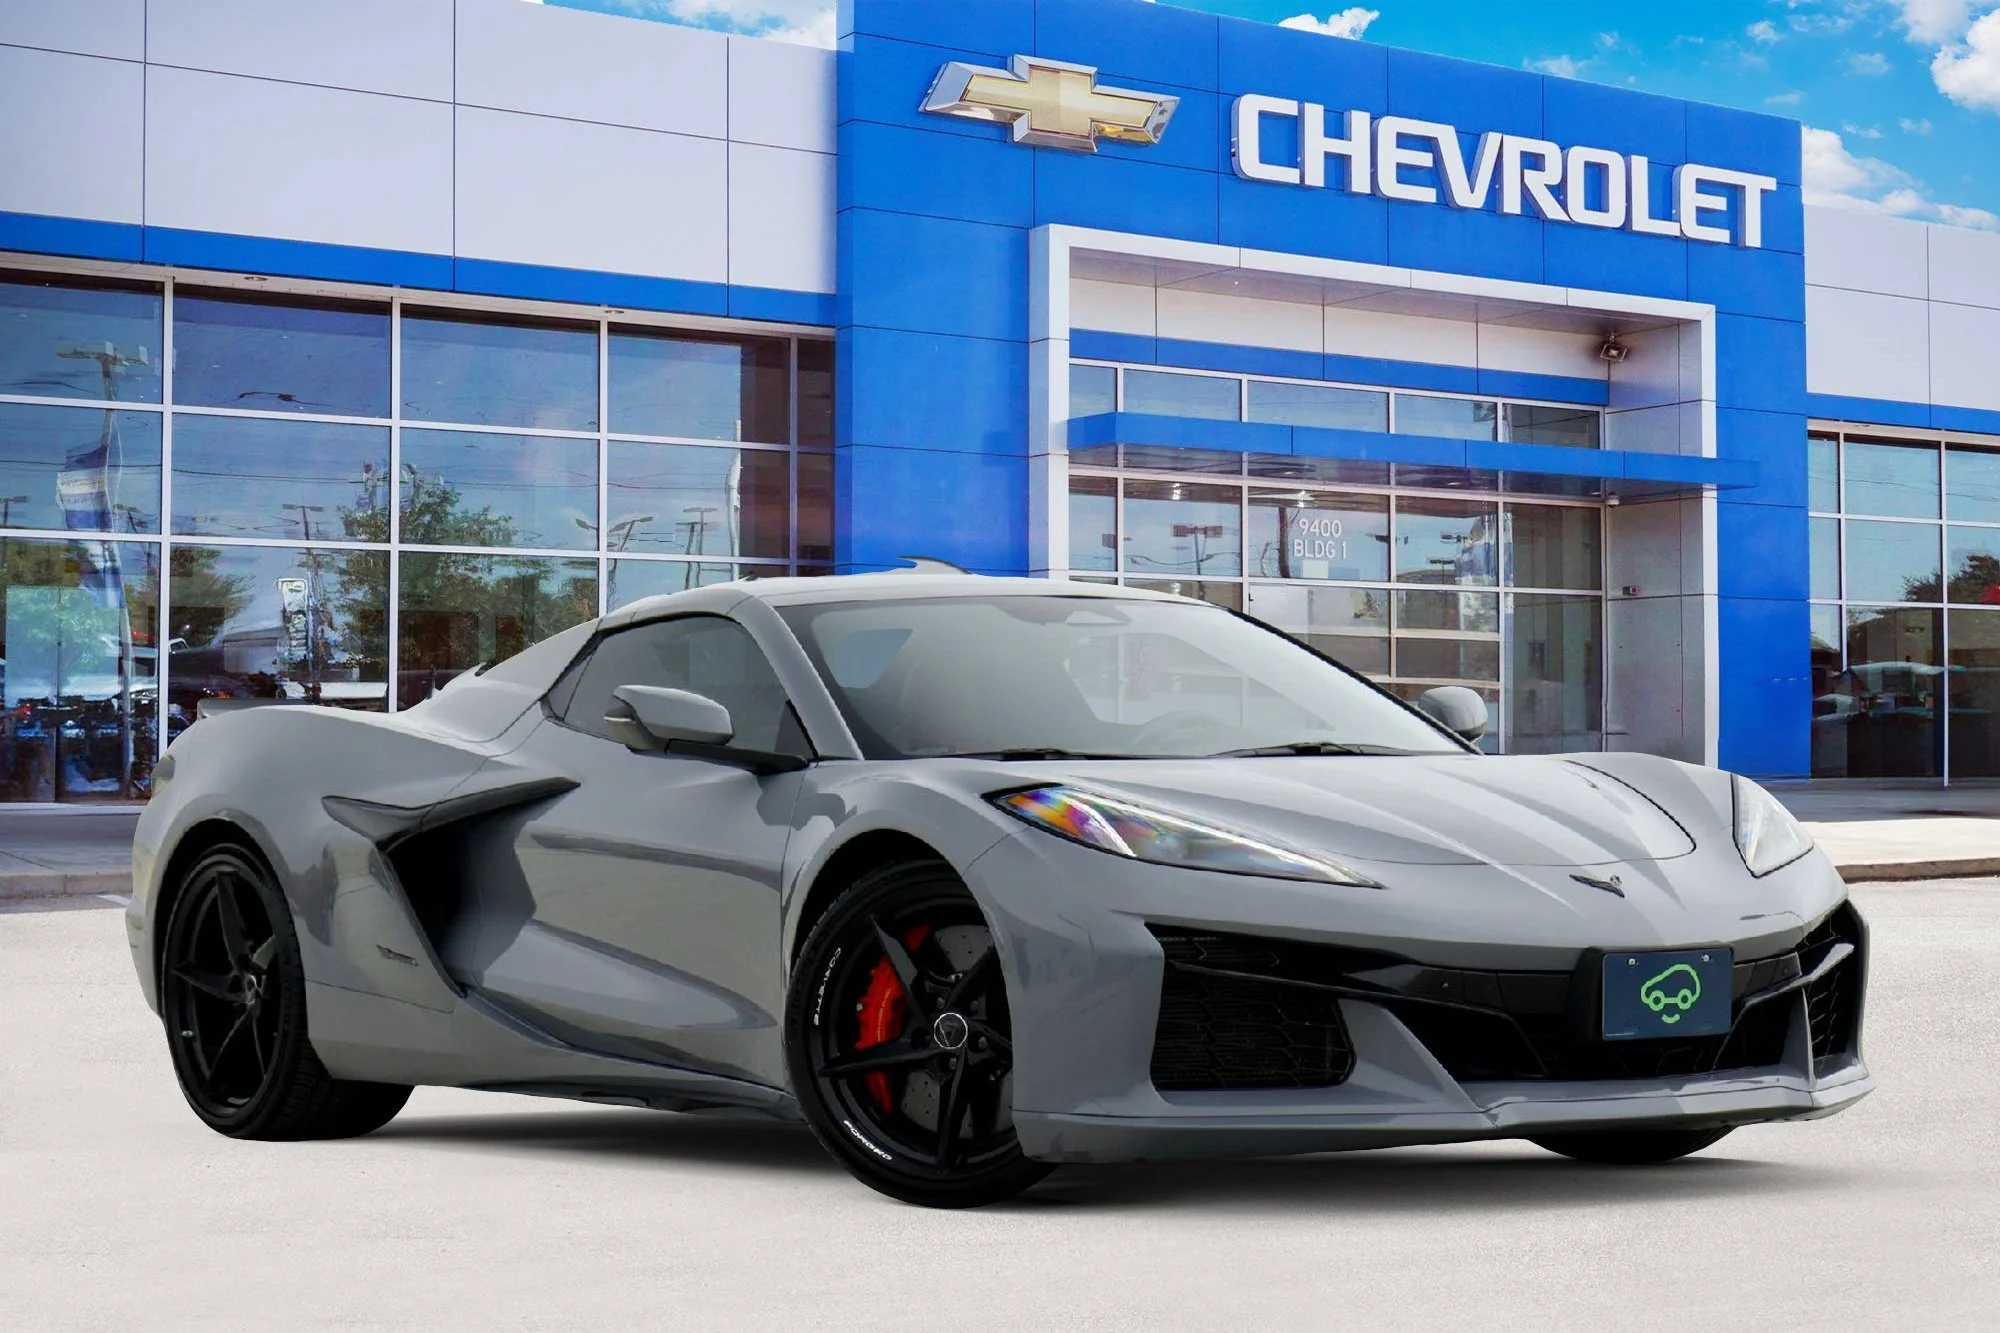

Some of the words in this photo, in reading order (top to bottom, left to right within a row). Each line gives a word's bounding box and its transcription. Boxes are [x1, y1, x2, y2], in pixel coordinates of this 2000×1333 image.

[1231, 93, 1777, 248] CHEVROLET
[1293, 539, 1336, 558] BLDG
[1342, 541, 1347, 559] 1
[1299, 519, 1342, 537] 9400
[813, 947, 842, 1026] CORVETTE
